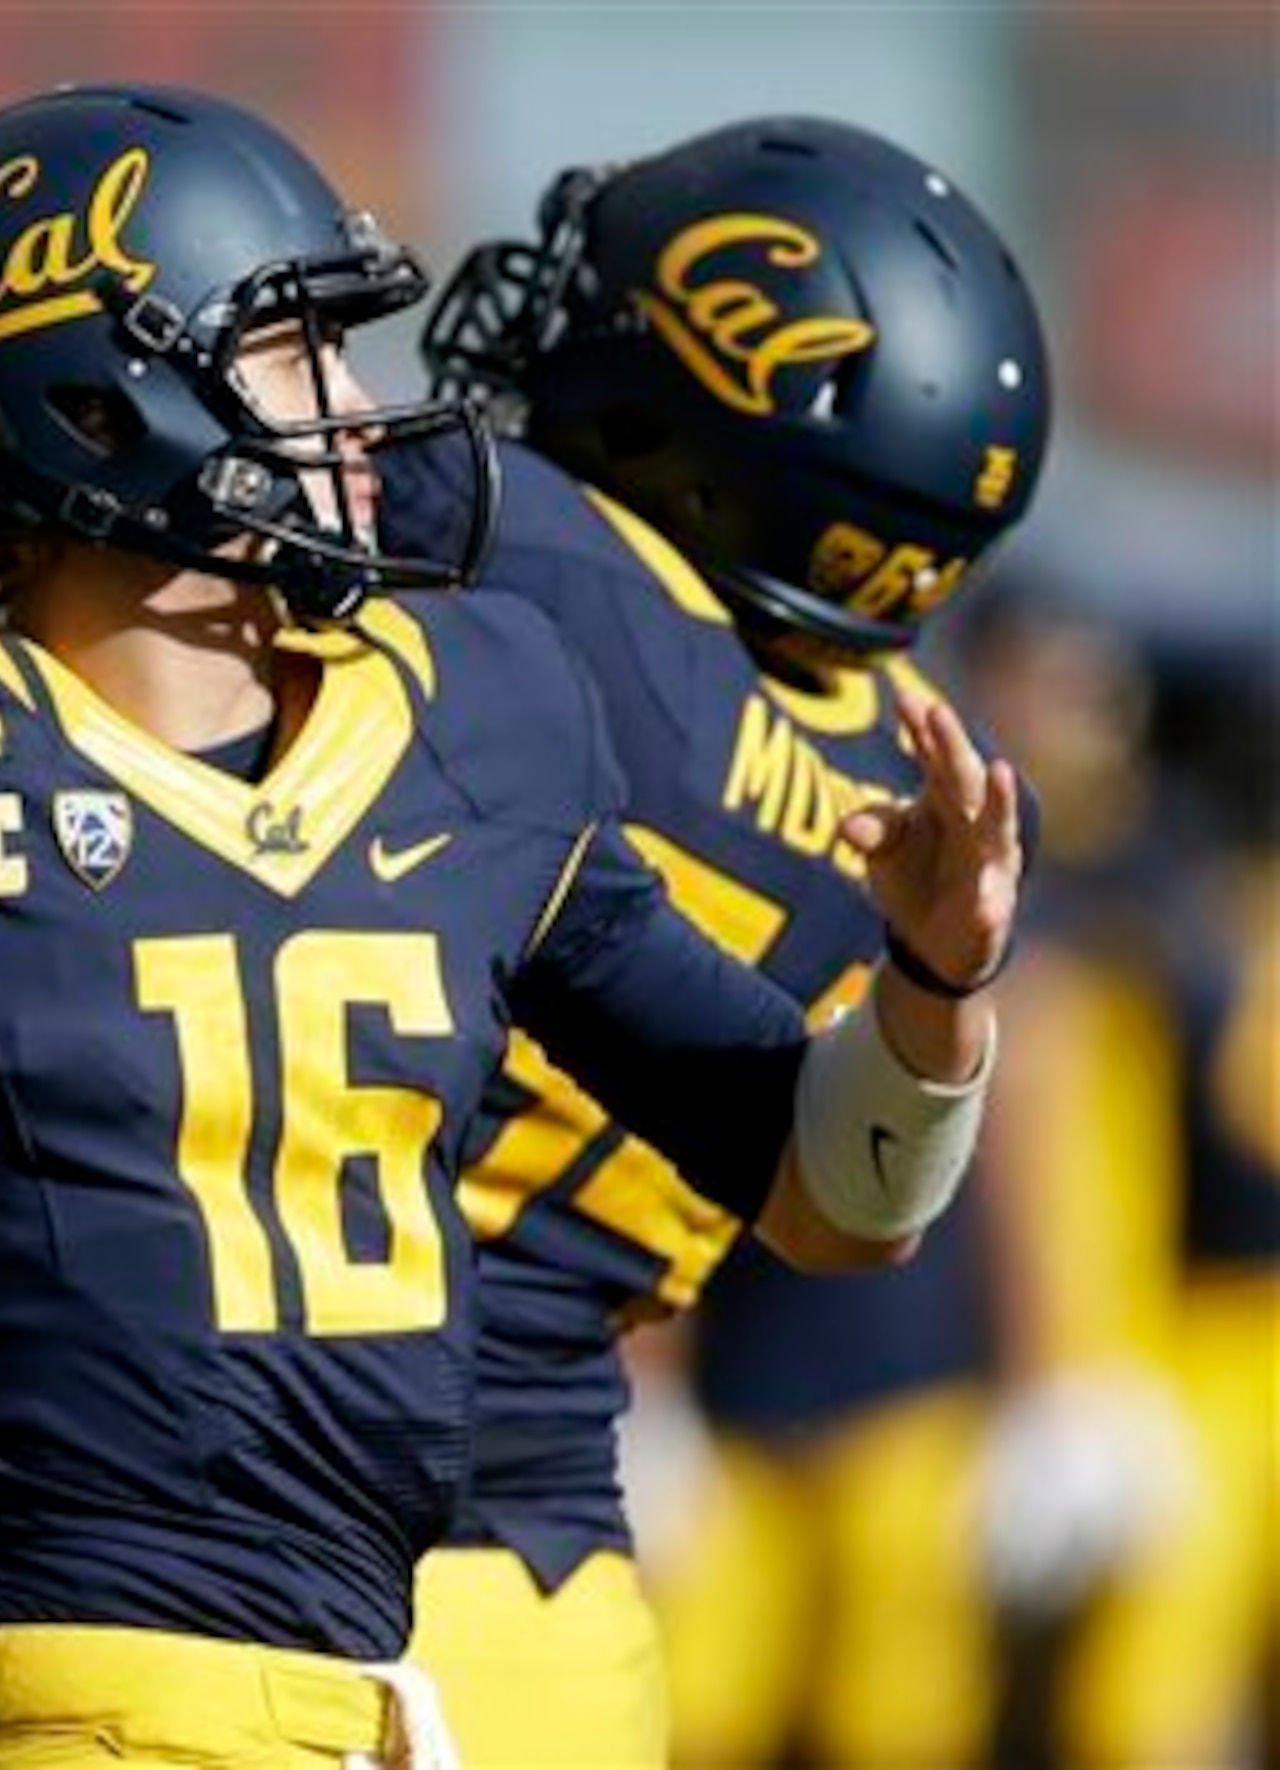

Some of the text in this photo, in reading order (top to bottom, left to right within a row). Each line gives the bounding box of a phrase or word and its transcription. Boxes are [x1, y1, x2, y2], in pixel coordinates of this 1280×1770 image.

[648, 213, 876, 415] Cal
[245, 800, 309, 856] Cal
[132, 930, 454, 1337] 16
